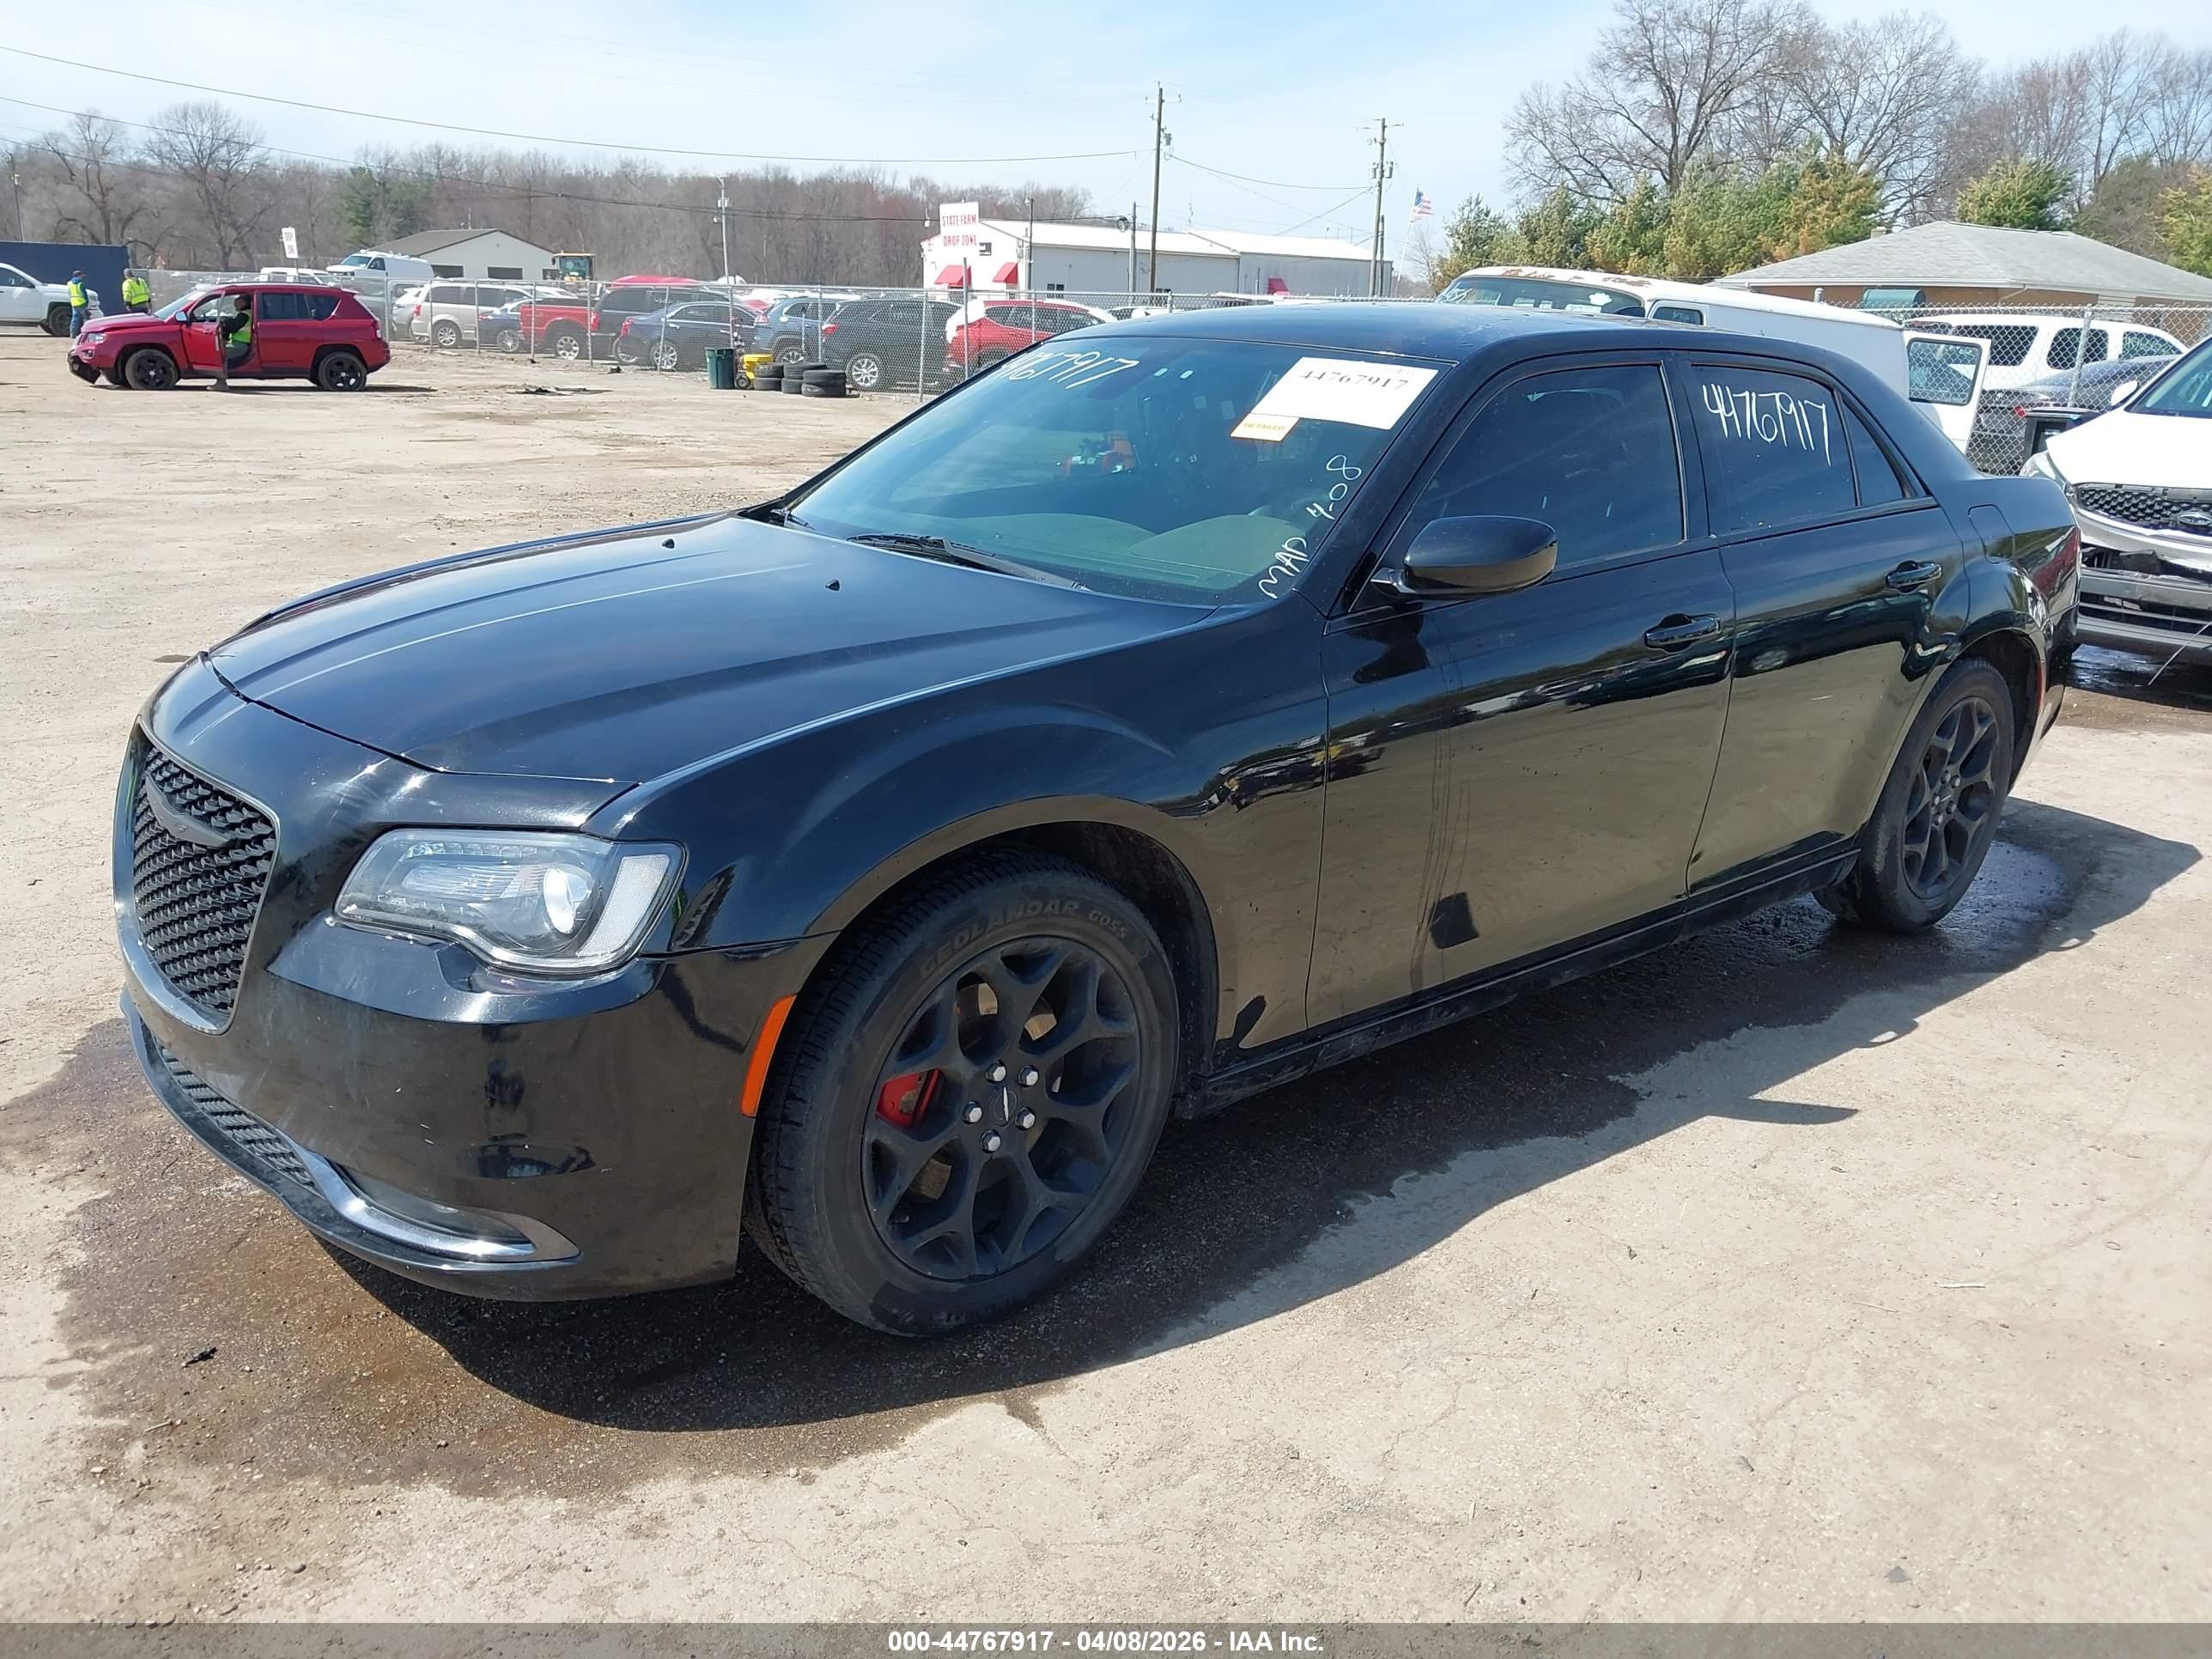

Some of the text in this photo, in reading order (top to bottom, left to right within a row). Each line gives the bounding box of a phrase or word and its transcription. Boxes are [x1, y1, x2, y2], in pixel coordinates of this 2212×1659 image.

[942, 214, 976, 227] STATE FARM
[944, 234, 977, 246] DROP ZONE
[1299, 370, 1409, 390] 44767917
[1702, 383, 1831, 468] 44767917
[920, 899, 1079, 979] GEOLANDAR
